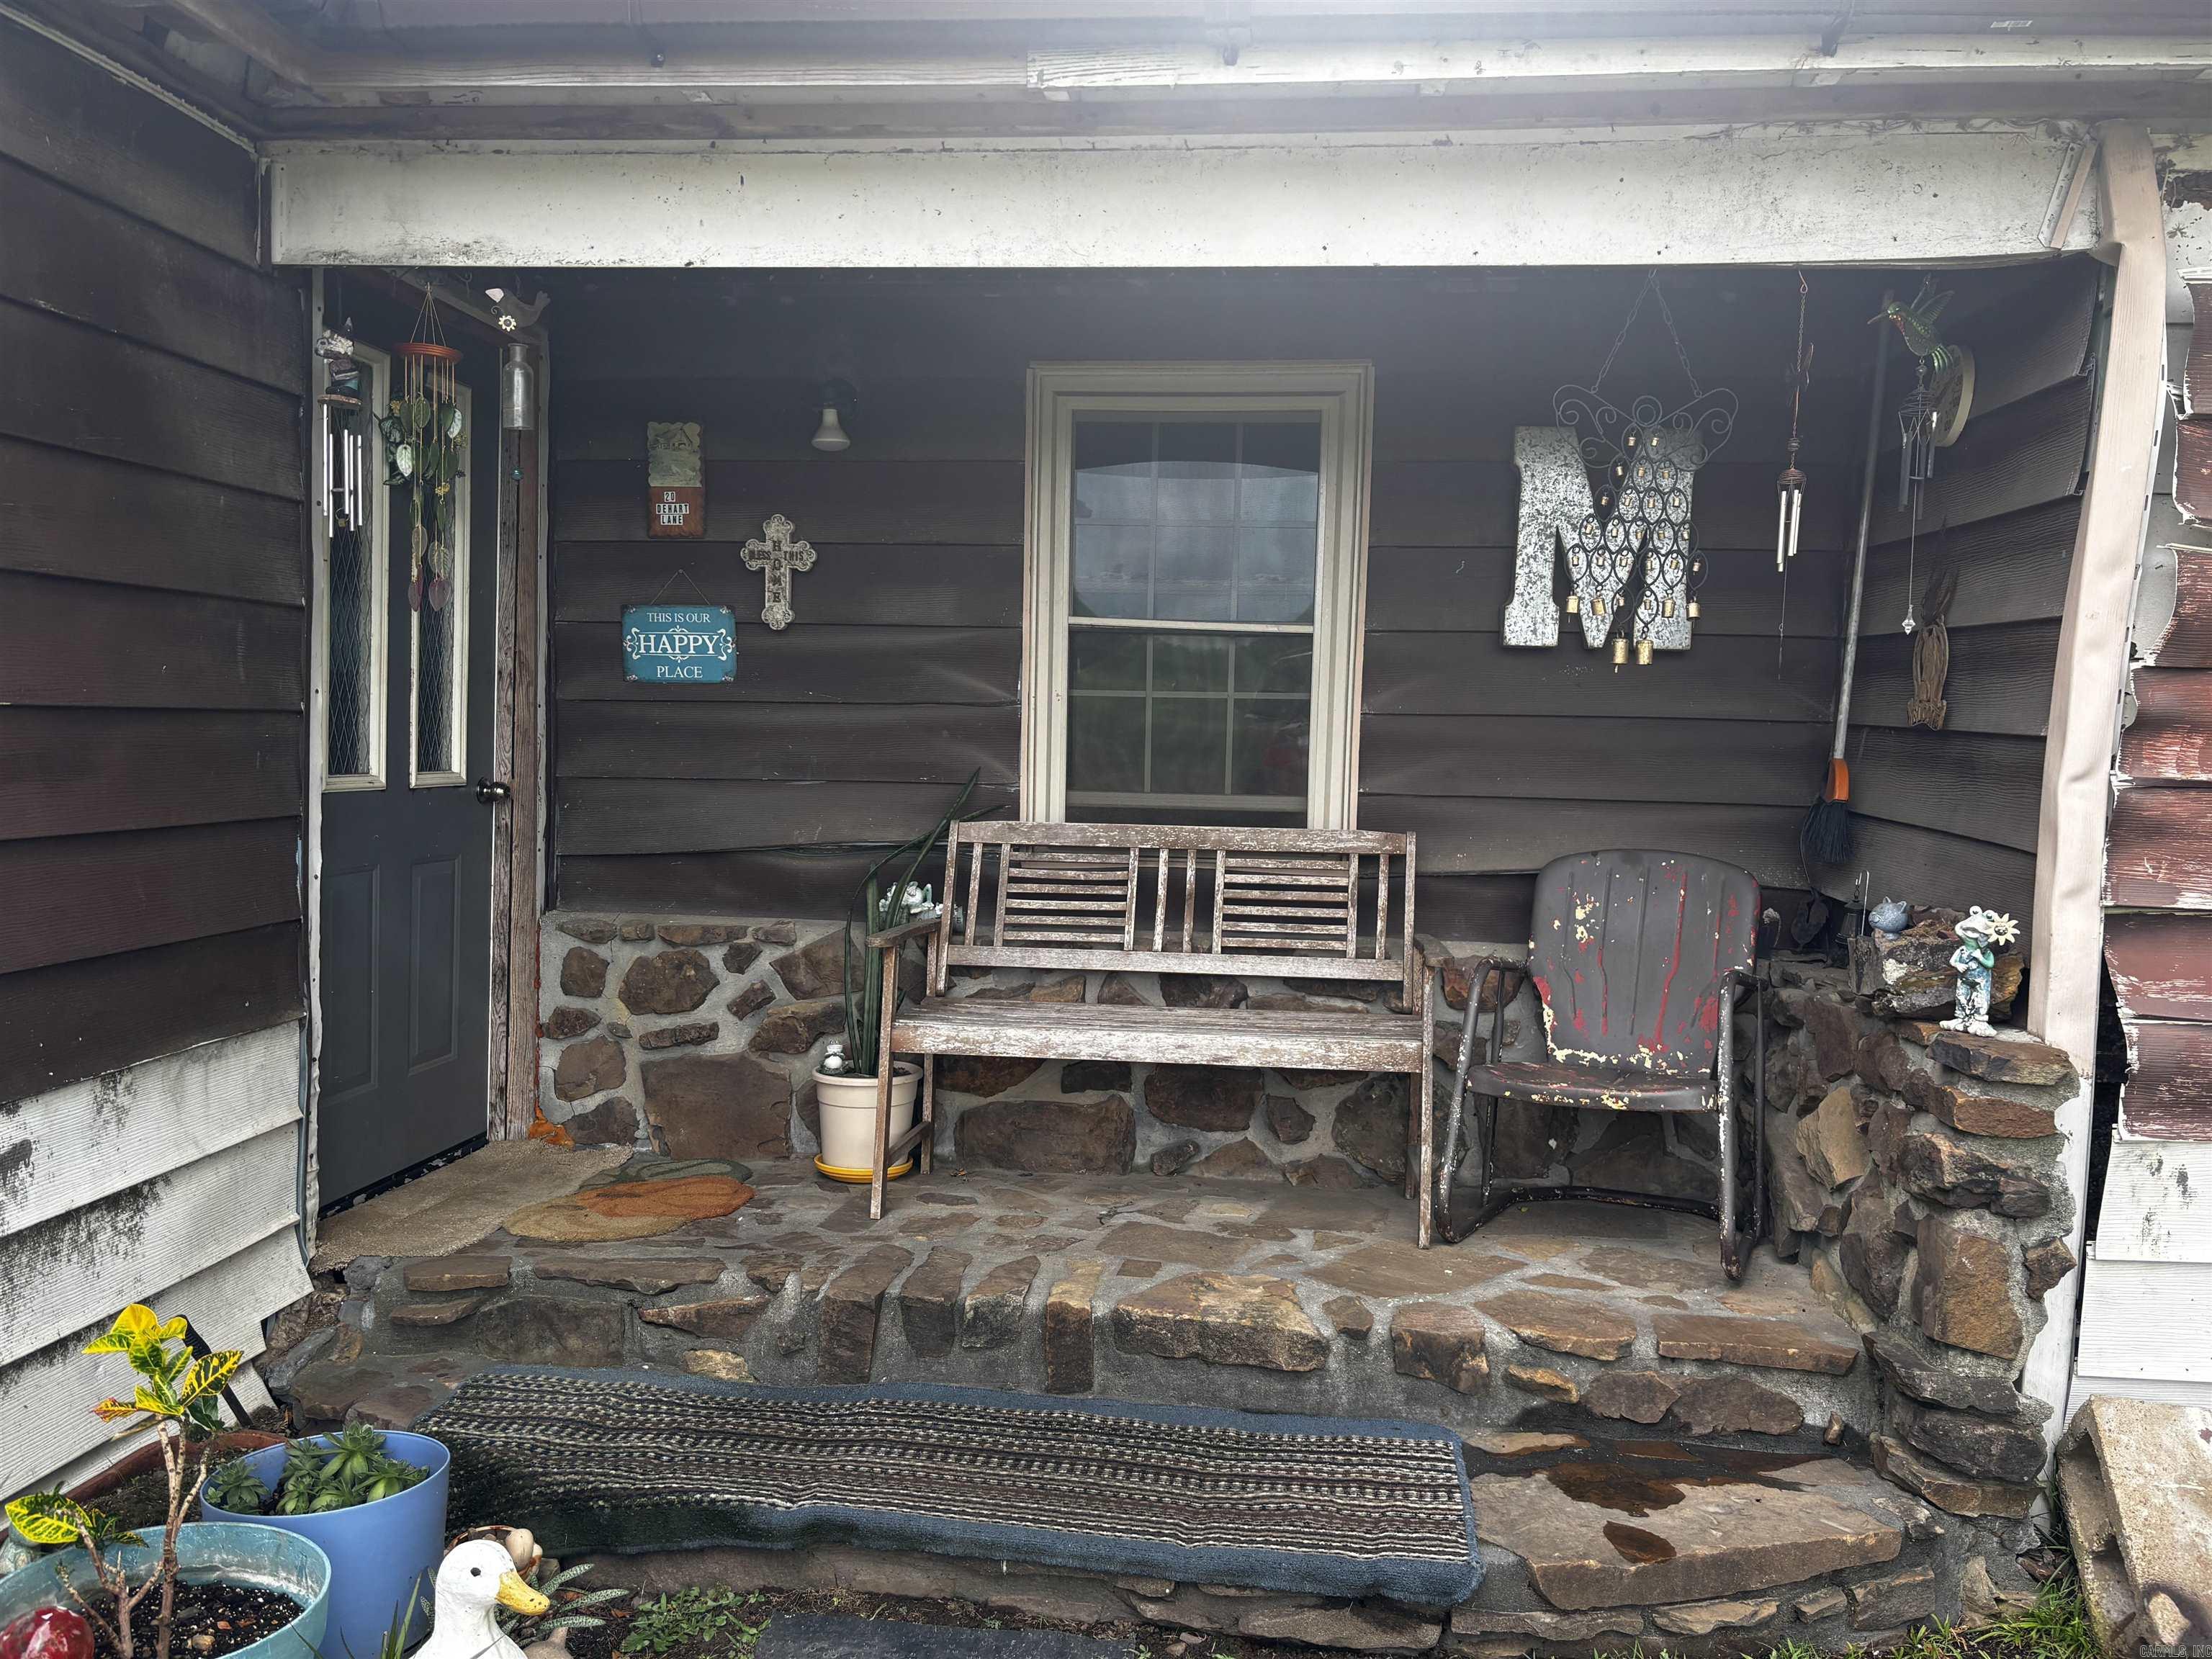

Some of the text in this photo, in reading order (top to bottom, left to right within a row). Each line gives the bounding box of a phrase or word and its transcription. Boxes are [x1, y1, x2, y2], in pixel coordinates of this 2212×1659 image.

[665, 493, 675, 501] 20
[657, 504, 688, 513] DEHART
[662, 515, 683, 524] LANE
[783, 550, 804, 562] THIS
[647, 612, 711, 623] THIS IS OUR
[638, 634, 719, 655] HAPPY
[656, 665, 703, 678] PLACE
